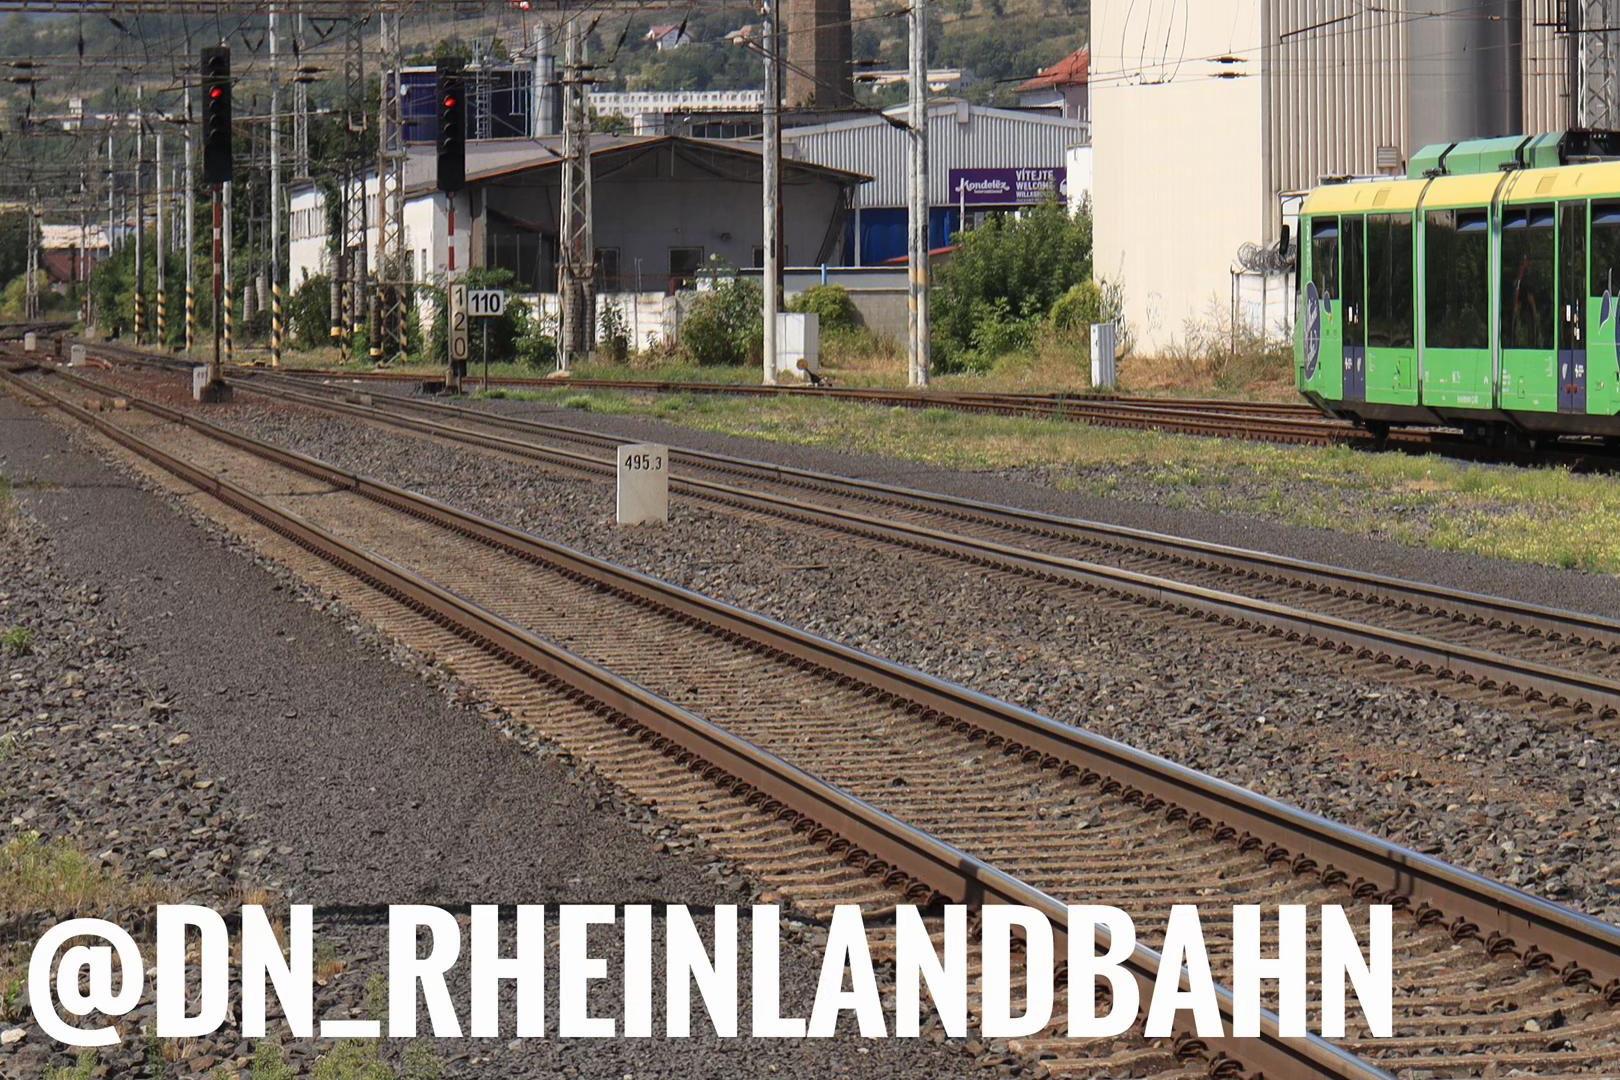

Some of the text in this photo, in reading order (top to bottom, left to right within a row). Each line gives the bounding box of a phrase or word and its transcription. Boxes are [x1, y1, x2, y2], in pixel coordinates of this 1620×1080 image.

[1015, 168, 1054, 181] VÍTEJTE
[471, 293, 500, 313] 110
[454, 287, 466, 358] 120
[624, 454, 662, 471] 495.3
